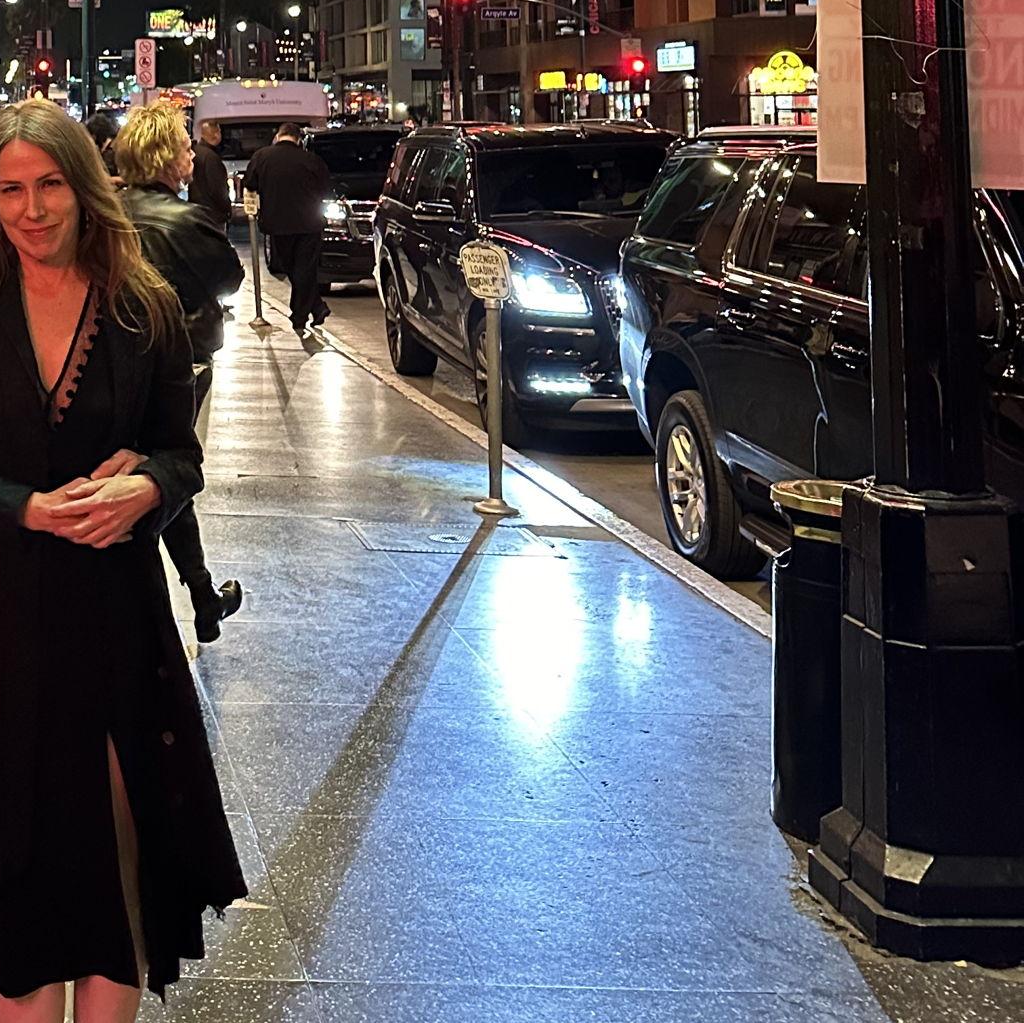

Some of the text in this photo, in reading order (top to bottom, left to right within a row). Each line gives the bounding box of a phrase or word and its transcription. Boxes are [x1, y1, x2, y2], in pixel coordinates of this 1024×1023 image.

[485, 10, 507, 18] Argyle
[463, 253, 500, 265] PASSENGER
[470, 265, 499, 276] LOADING
